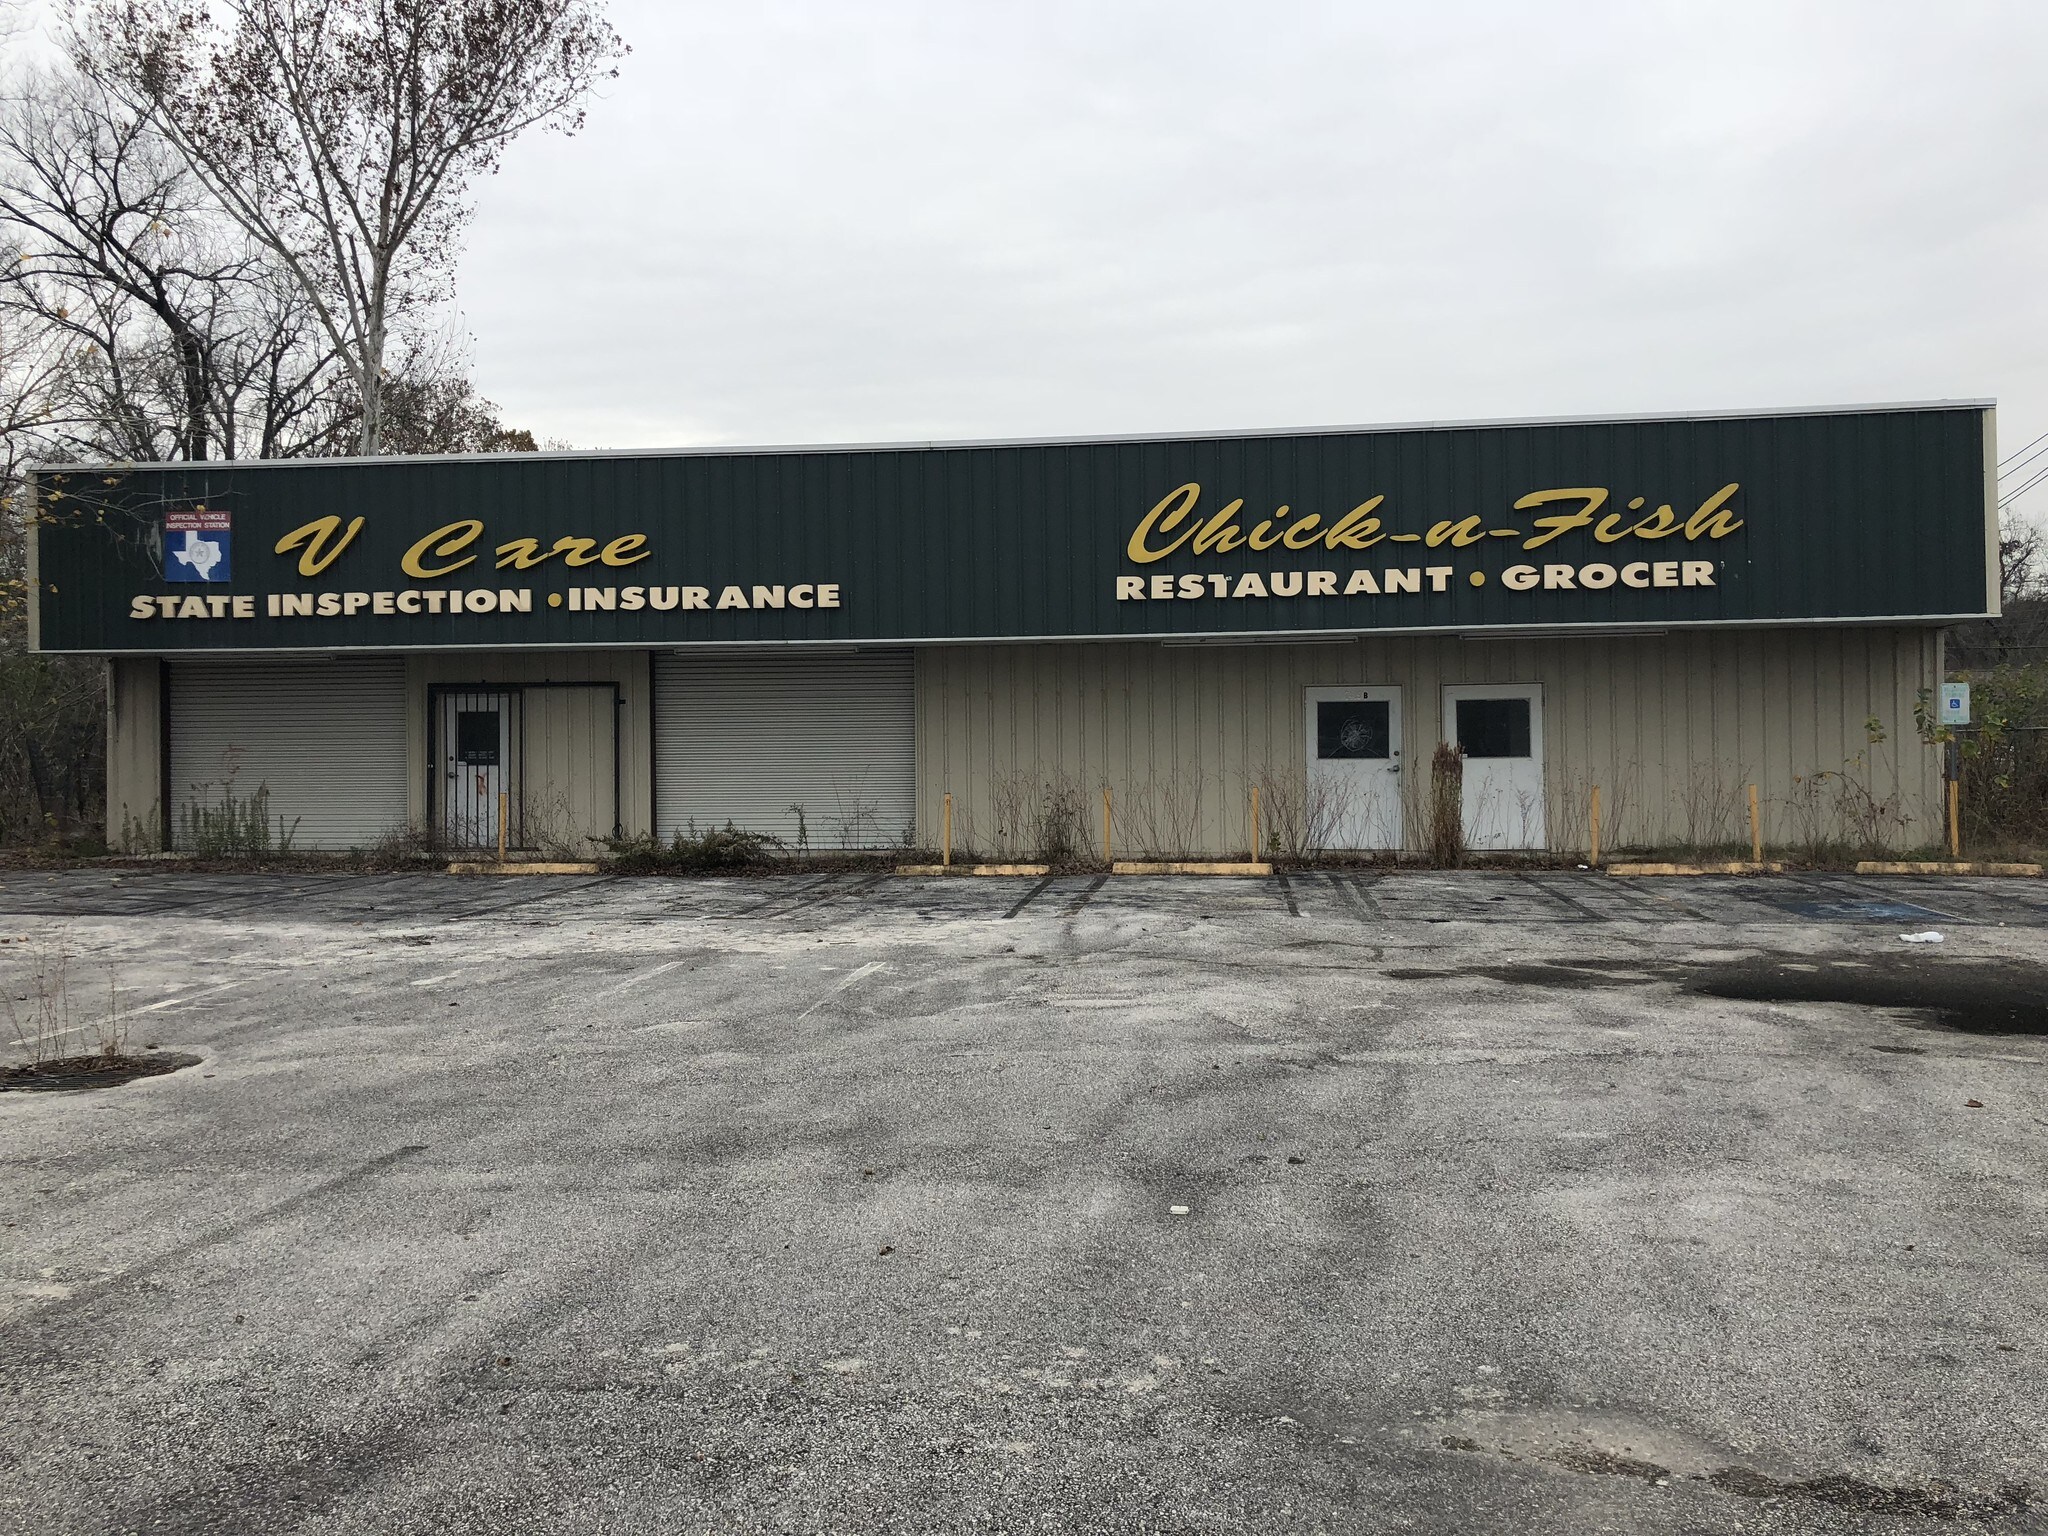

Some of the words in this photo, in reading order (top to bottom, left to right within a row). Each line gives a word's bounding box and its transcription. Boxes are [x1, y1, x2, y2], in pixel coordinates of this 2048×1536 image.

[166, 521, 202, 529] INSPECTION
[204, 521, 230, 529] STATION
[170, 513, 197, 521] OFFICIAL
[200, 513, 226, 521] VEHICLE
[1127, 482, 1744, 564] Chick-n-Fish
[274, 515, 365, 577] V
[401, 519, 651, 579] Care
[1116, 566, 1453, 601] RESTAURANT
[1501, 560, 1717, 591] GROCER
[129, 595, 255, 619] STATE
[267, 588, 532, 617] INSPECTION
[568, 583, 840, 611] INSURANCE
